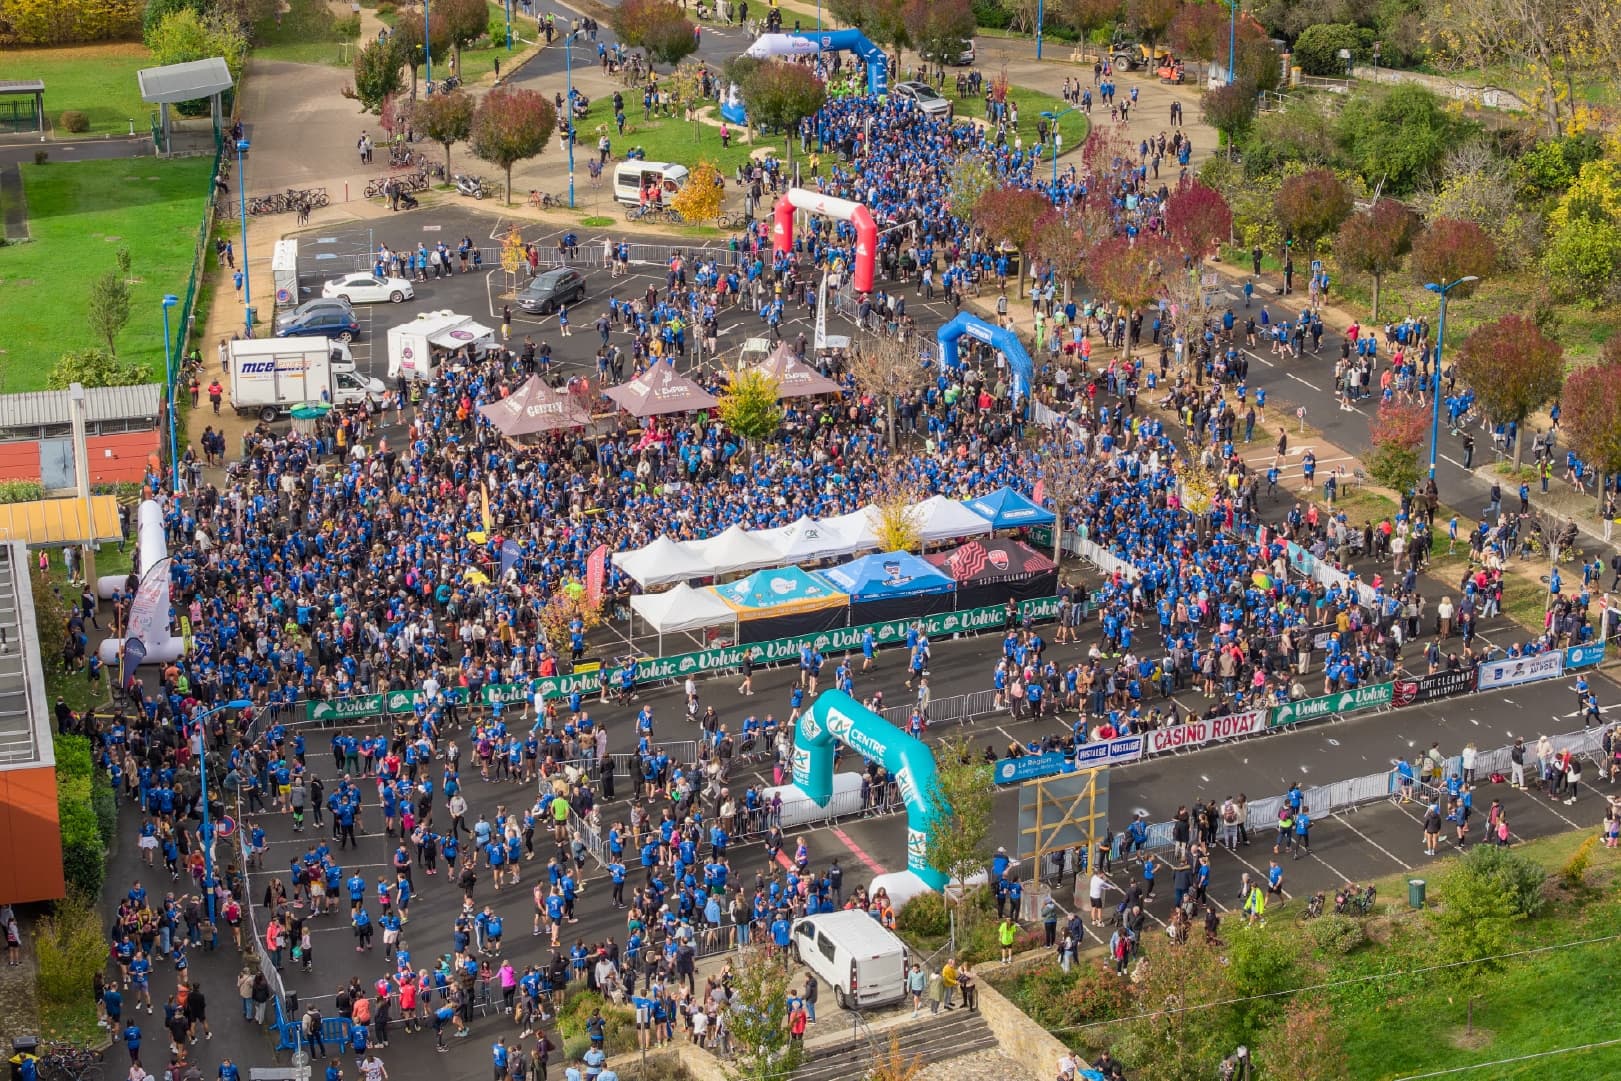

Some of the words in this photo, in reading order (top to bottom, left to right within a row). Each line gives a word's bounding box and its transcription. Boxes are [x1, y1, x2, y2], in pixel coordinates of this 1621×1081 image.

[961, 608, 1004, 628] Volvic
[1355, 686, 1390, 704] Volvic
[336, 699, 380, 713] Volvic
[1295, 701, 1330, 716] Volvic
[1153, 723, 1207, 751] CASINO
[1212, 713, 1257, 739] ROYAT
[851, 729, 888, 757] CENTRE
[1111, 740, 1141, 755] NOSTALGIE
[1080, 747, 1107, 760] NOSTALGIE
